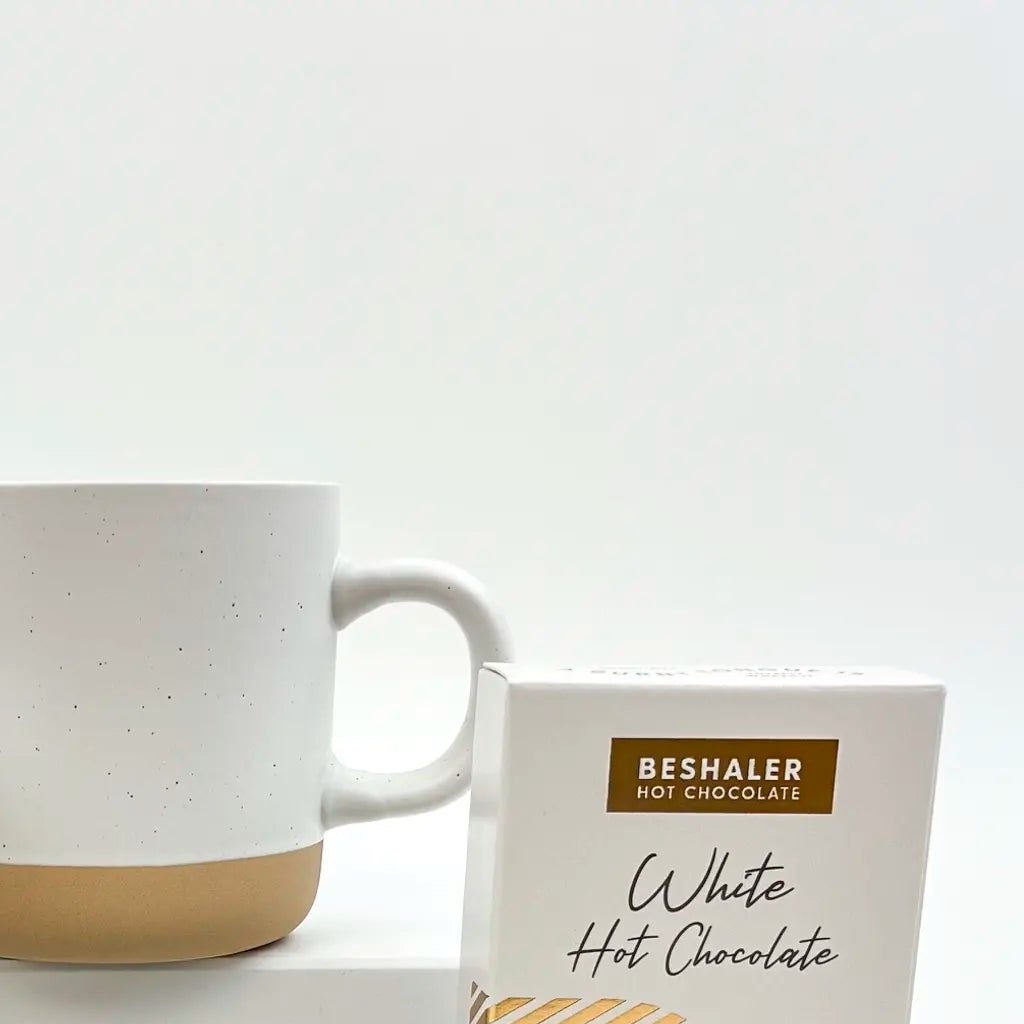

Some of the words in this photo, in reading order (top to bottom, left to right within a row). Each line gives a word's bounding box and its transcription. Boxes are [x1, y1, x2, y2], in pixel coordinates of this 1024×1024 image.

[637, 757, 802, 782] BESHALER
[637, 785, 675, 800] HOT
[684, 785, 801, 801] CHOCOLATE
[628, 847, 795, 913] White
[567, 918, 659, 979] Hot
[665, 921, 839, 977] Chocolate
